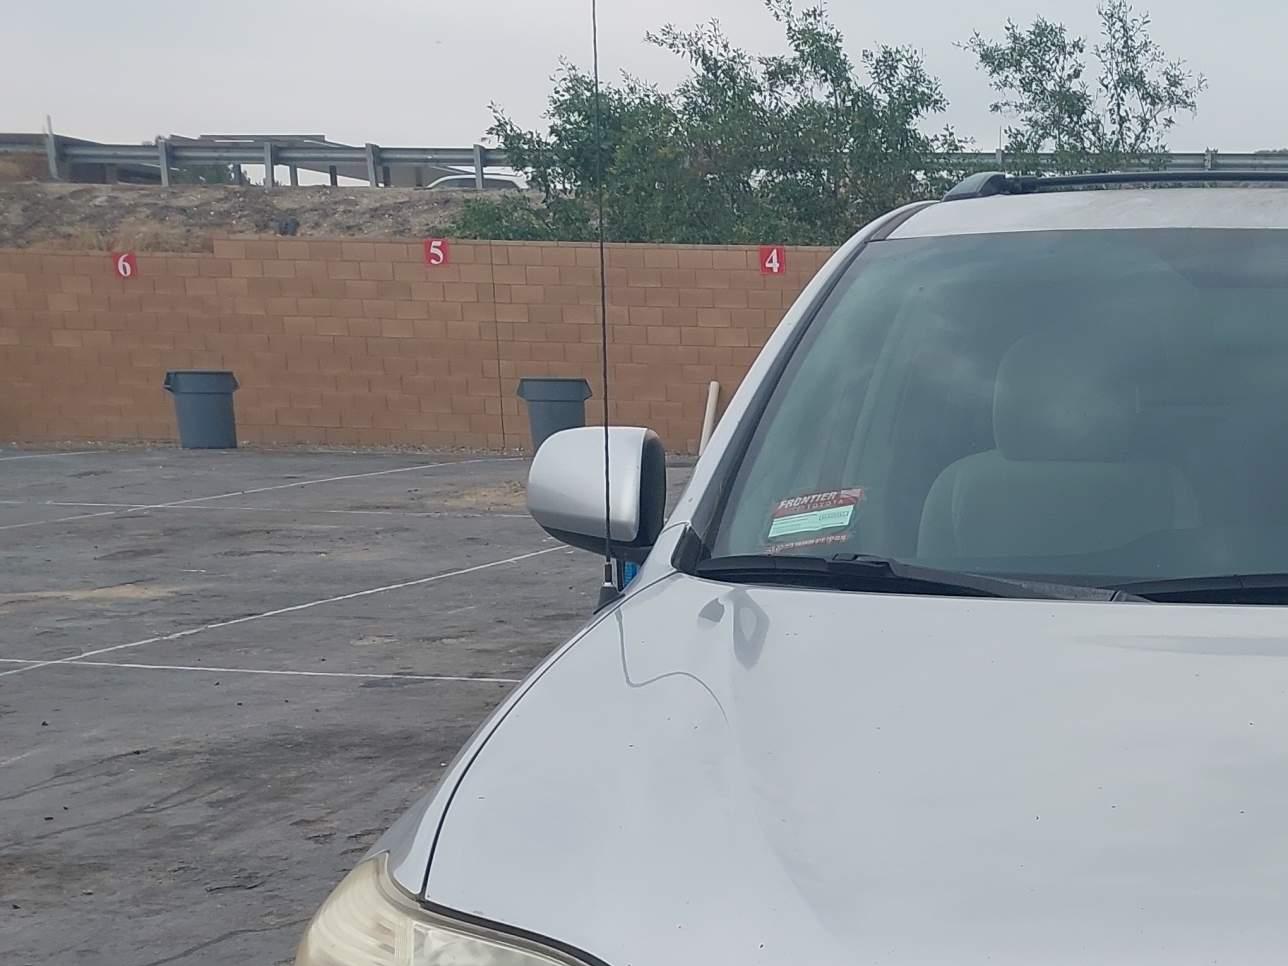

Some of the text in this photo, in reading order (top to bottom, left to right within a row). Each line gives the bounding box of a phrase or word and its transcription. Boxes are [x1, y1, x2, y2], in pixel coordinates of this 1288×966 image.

[430, 240, 443, 265] 5
[765, 248, 780, 273] 4
[118, 253, 131, 277] 6
[779, 491, 837, 508] FRONTIER
